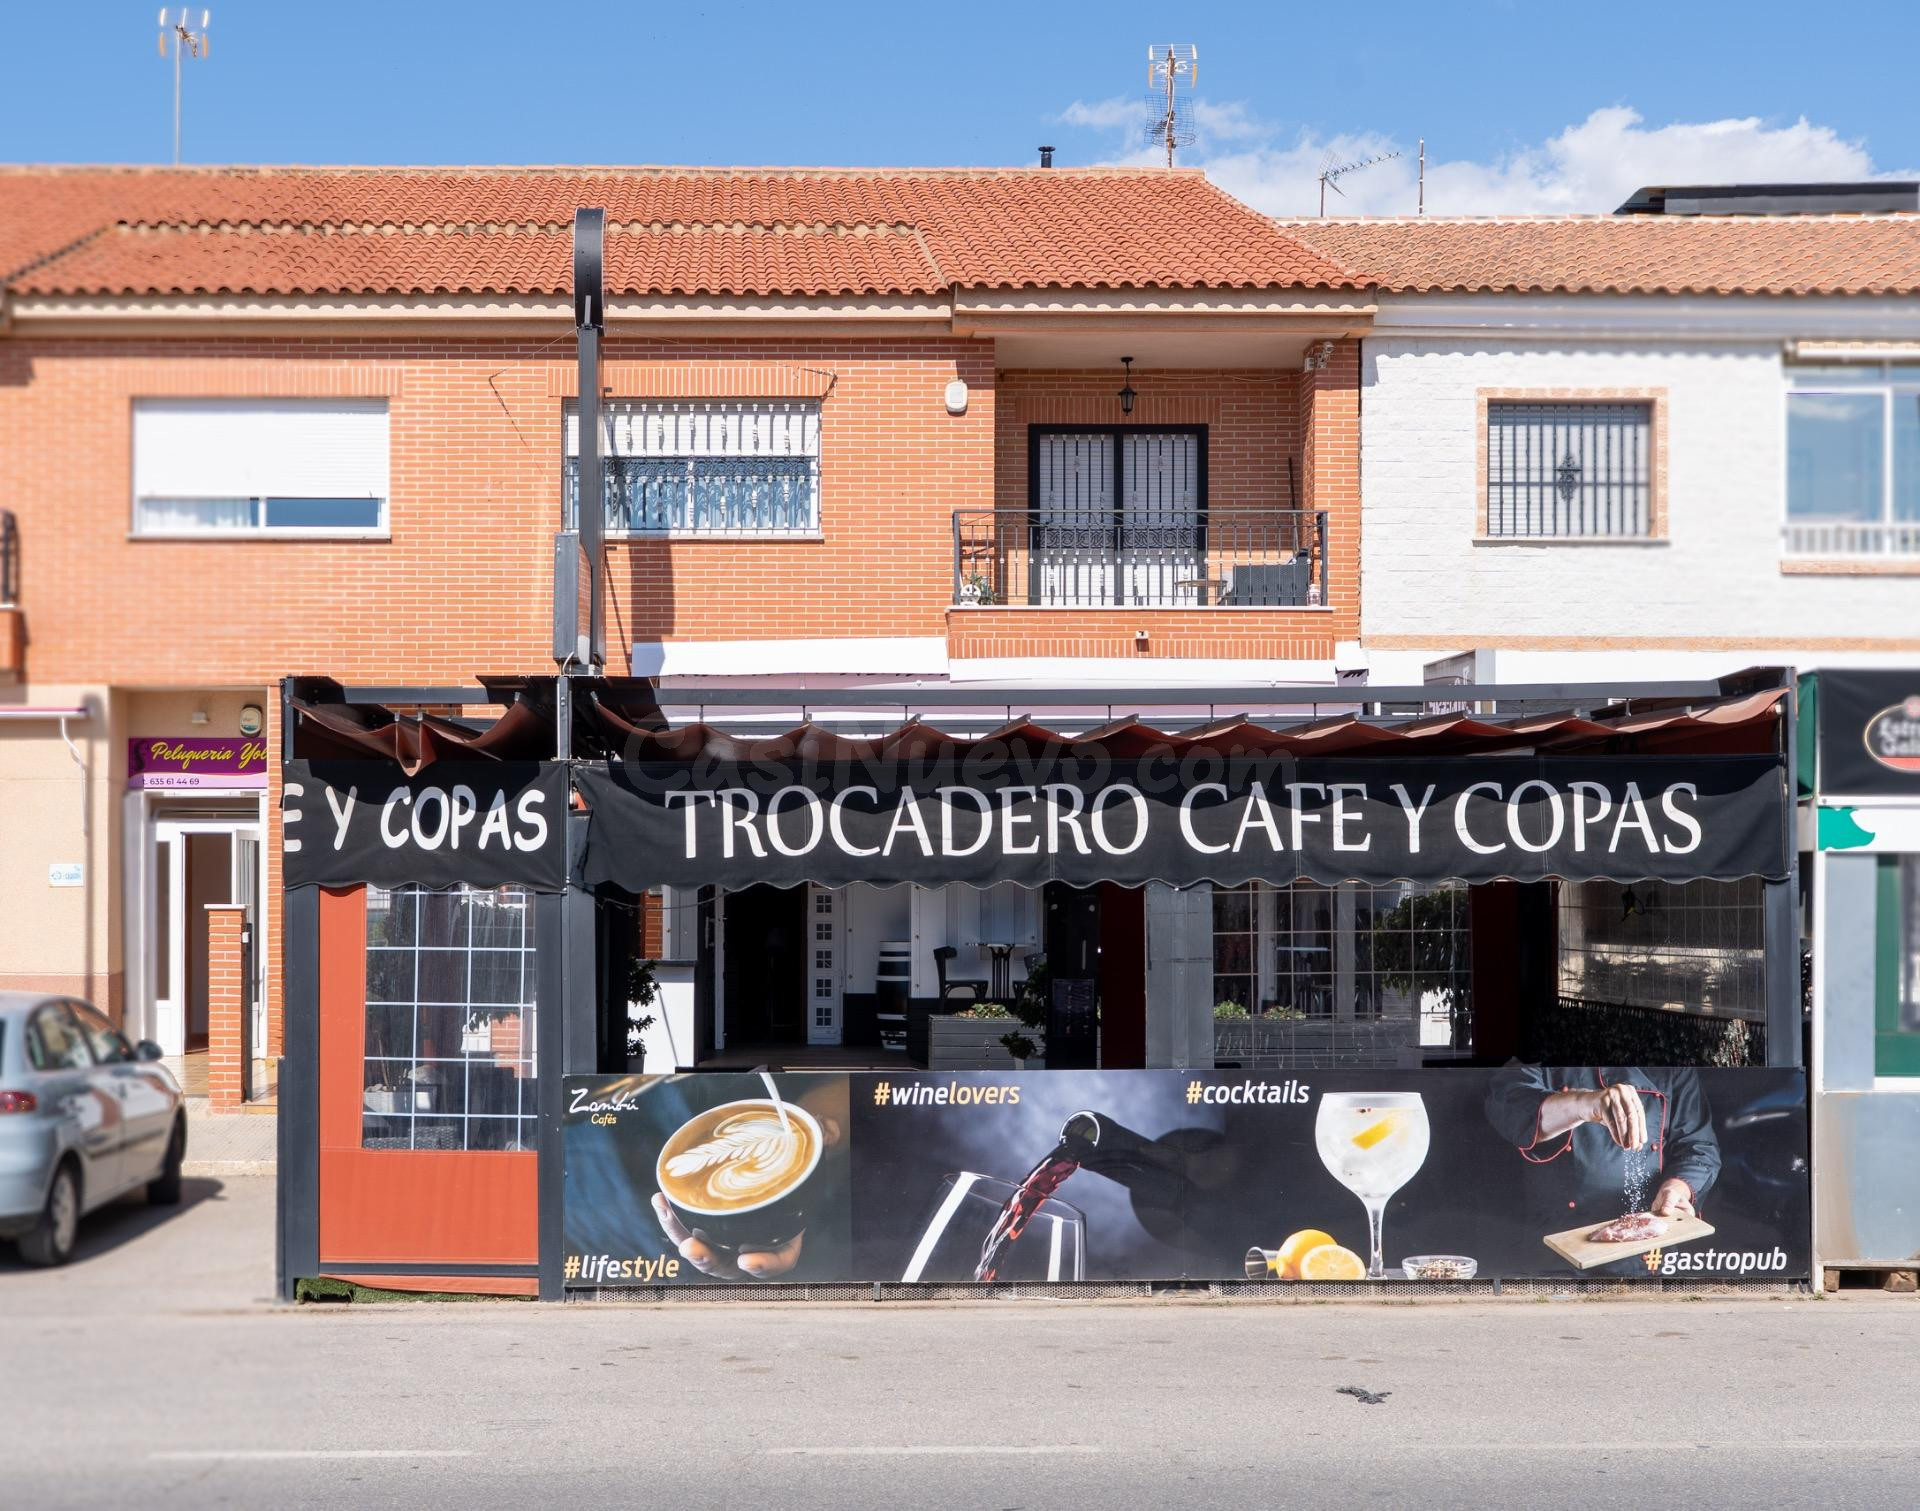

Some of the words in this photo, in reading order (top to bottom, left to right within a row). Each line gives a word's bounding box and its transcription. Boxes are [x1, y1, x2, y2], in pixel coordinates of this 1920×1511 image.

[325, 785, 358, 850] Y
[380, 784, 548, 851] COPAS
[665, 783, 1149, 858] TROCADERO
[1178, 781, 1372, 854] CAFE
[1389, 783, 1437, 854] Y
[1454, 780, 1702, 855] COPAS
[874, 1081, 1021, 1105] #winelovers
[1186, 1080, 1310, 1104] #cocktails
[564, 1254, 680, 1282] #lifestyle
[1645, 1247, 1787, 1275] #gastropub
